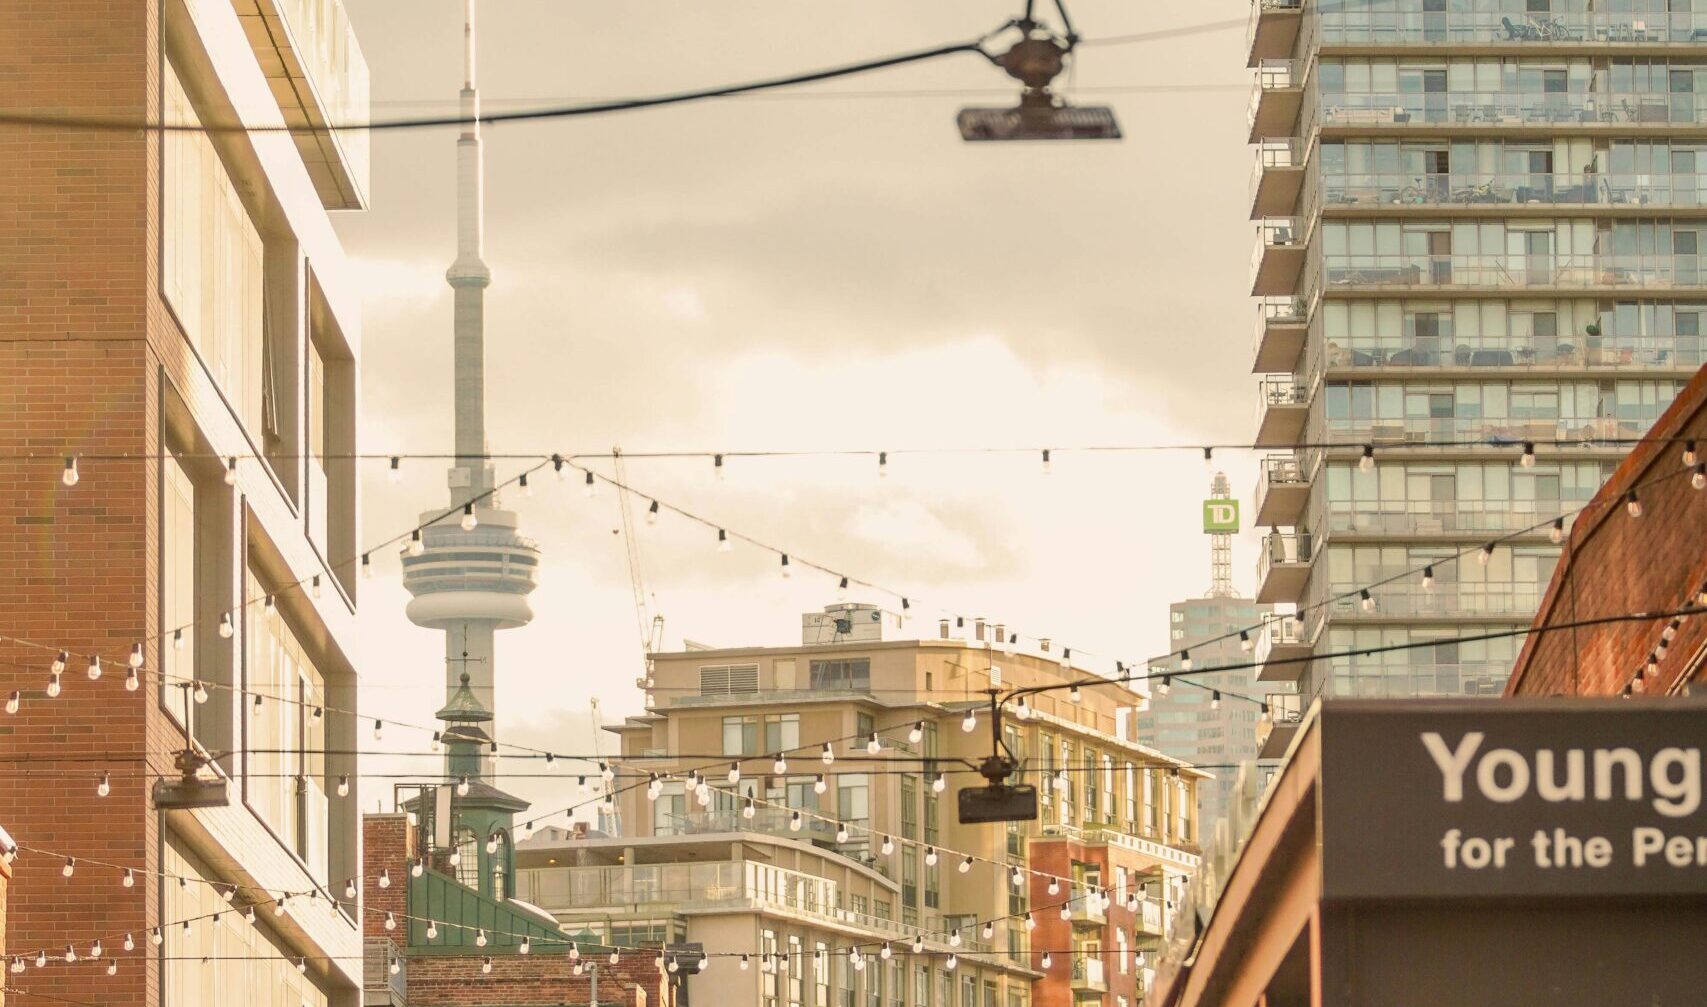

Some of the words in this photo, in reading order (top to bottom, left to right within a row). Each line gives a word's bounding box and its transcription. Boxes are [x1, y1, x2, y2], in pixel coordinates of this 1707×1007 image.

[1207, 504, 1236, 524] TD
[1421, 732, 1701, 817] Young
[1441, 829, 1515, 869] for
[1532, 828, 1613, 868] the
